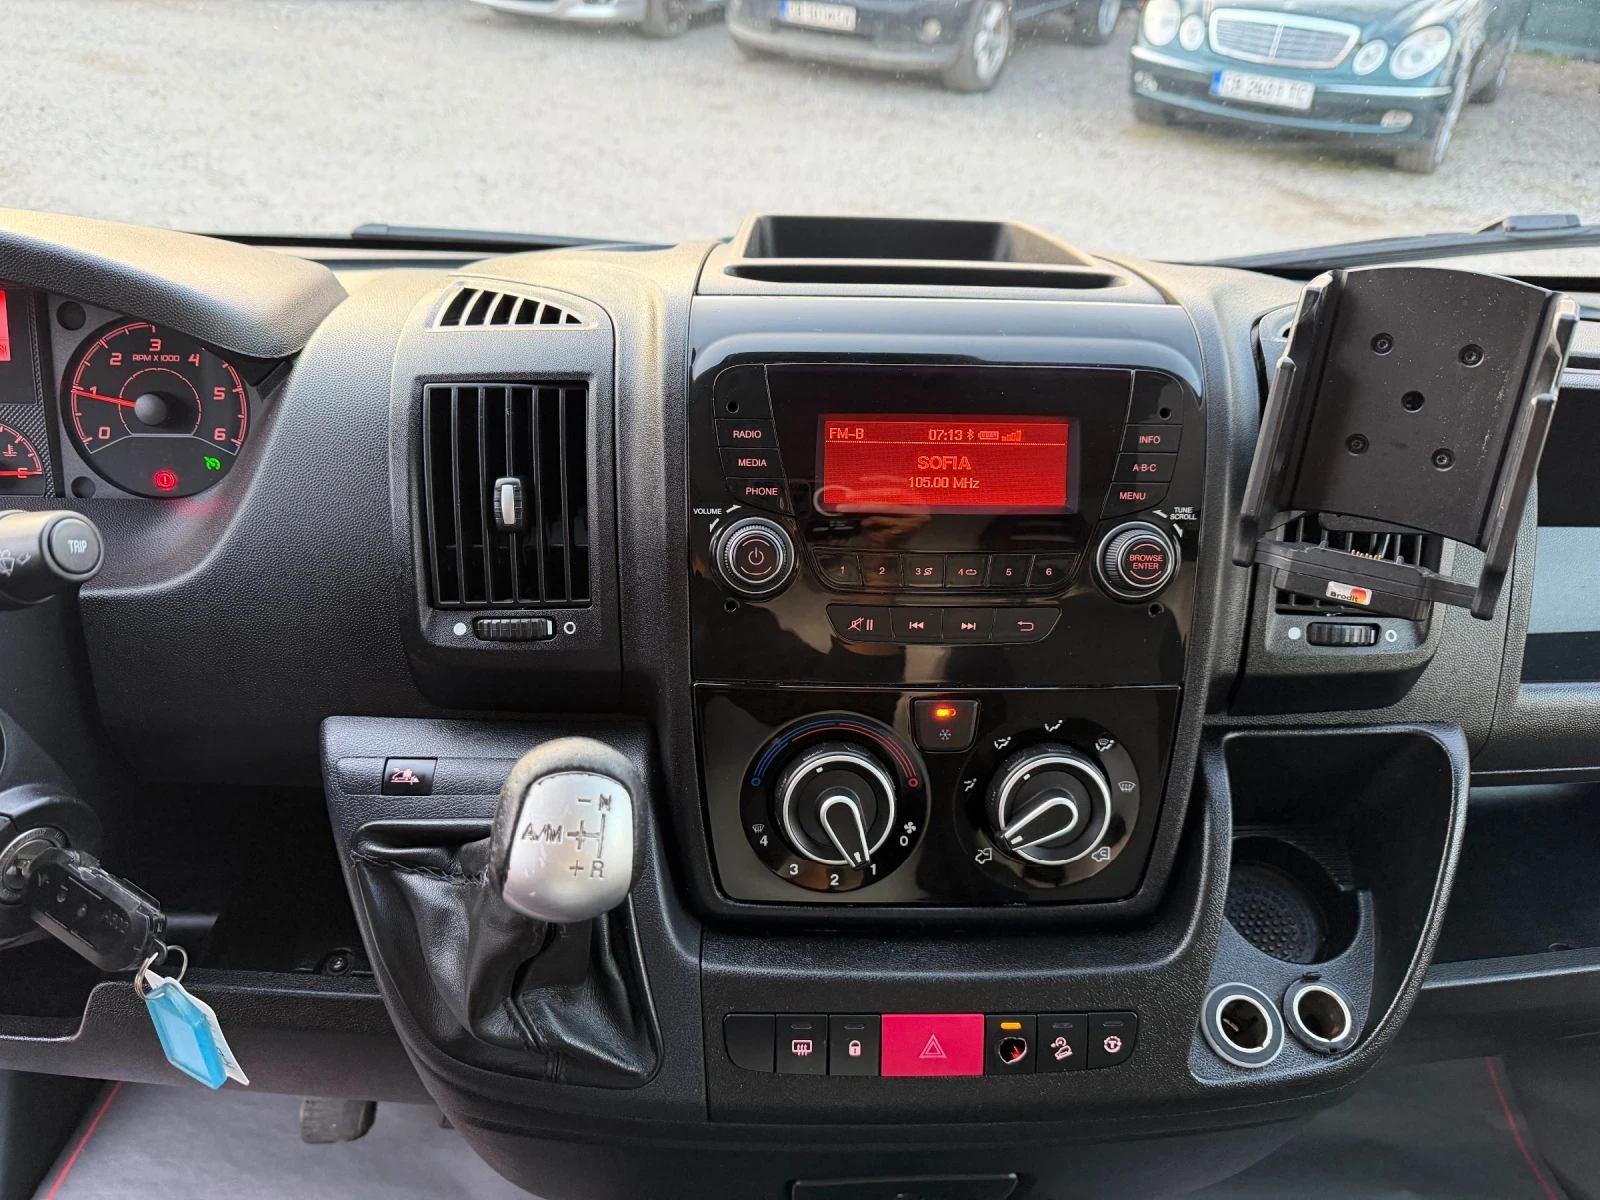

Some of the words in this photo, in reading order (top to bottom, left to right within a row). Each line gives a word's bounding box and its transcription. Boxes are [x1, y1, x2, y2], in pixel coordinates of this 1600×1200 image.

[149, 338, 162, 352] 3
[110, 352, 122, 366] 2
[132, 354, 152, 362] RPM
[160, 354, 180, 362] 1000
[188, 353, 200, 367] 4
[213, 387, 226, 400] 5
[98, 427, 111, 440] 0
[214, 428, 227, 441] 6
[732, 430, 762, 439] RADIO
[829, 427, 864, 440] FM-B
[928, 429, 963, 441] 07:13
[1138, 435, 1161, 444] INFO
[737, 458, 767, 467] MEDIA
[917, 455, 972, 471] SOFIA
[908, 476, 950, 489] 105.00
[953, 477, 980, 489] MHz
[745, 486, 779, 496] PHONE
[1119, 491, 1147, 500] MENU
[693, 507, 723, 515] VOLUME
[1173, 506, 1193, 514] TUNE
[1169, 513, 1197, 521] SCROLL
[67, 539, 88, 553] TRIP
[1129, 554, 1164, 562] BROWSE
[840, 566, 846, 575] 1
[878, 566, 886, 575] 2
[915, 567, 922, 576] 3
[1132, 562, 1160, 570] ENTER
[957, 568, 964, 576] 4
[1005, 568, 1012, 576] 5
[1045, 568, 1052, 576] 6
[598, 793, 613, 812] N
[759, 835, 769, 847] 4
[899, 835, 909, 847] 0
[590, 860, 605, 878] R
[789, 863, 799, 875] 3
[870, 863, 877, 875] 1
[830, 874, 840, 886] 2
